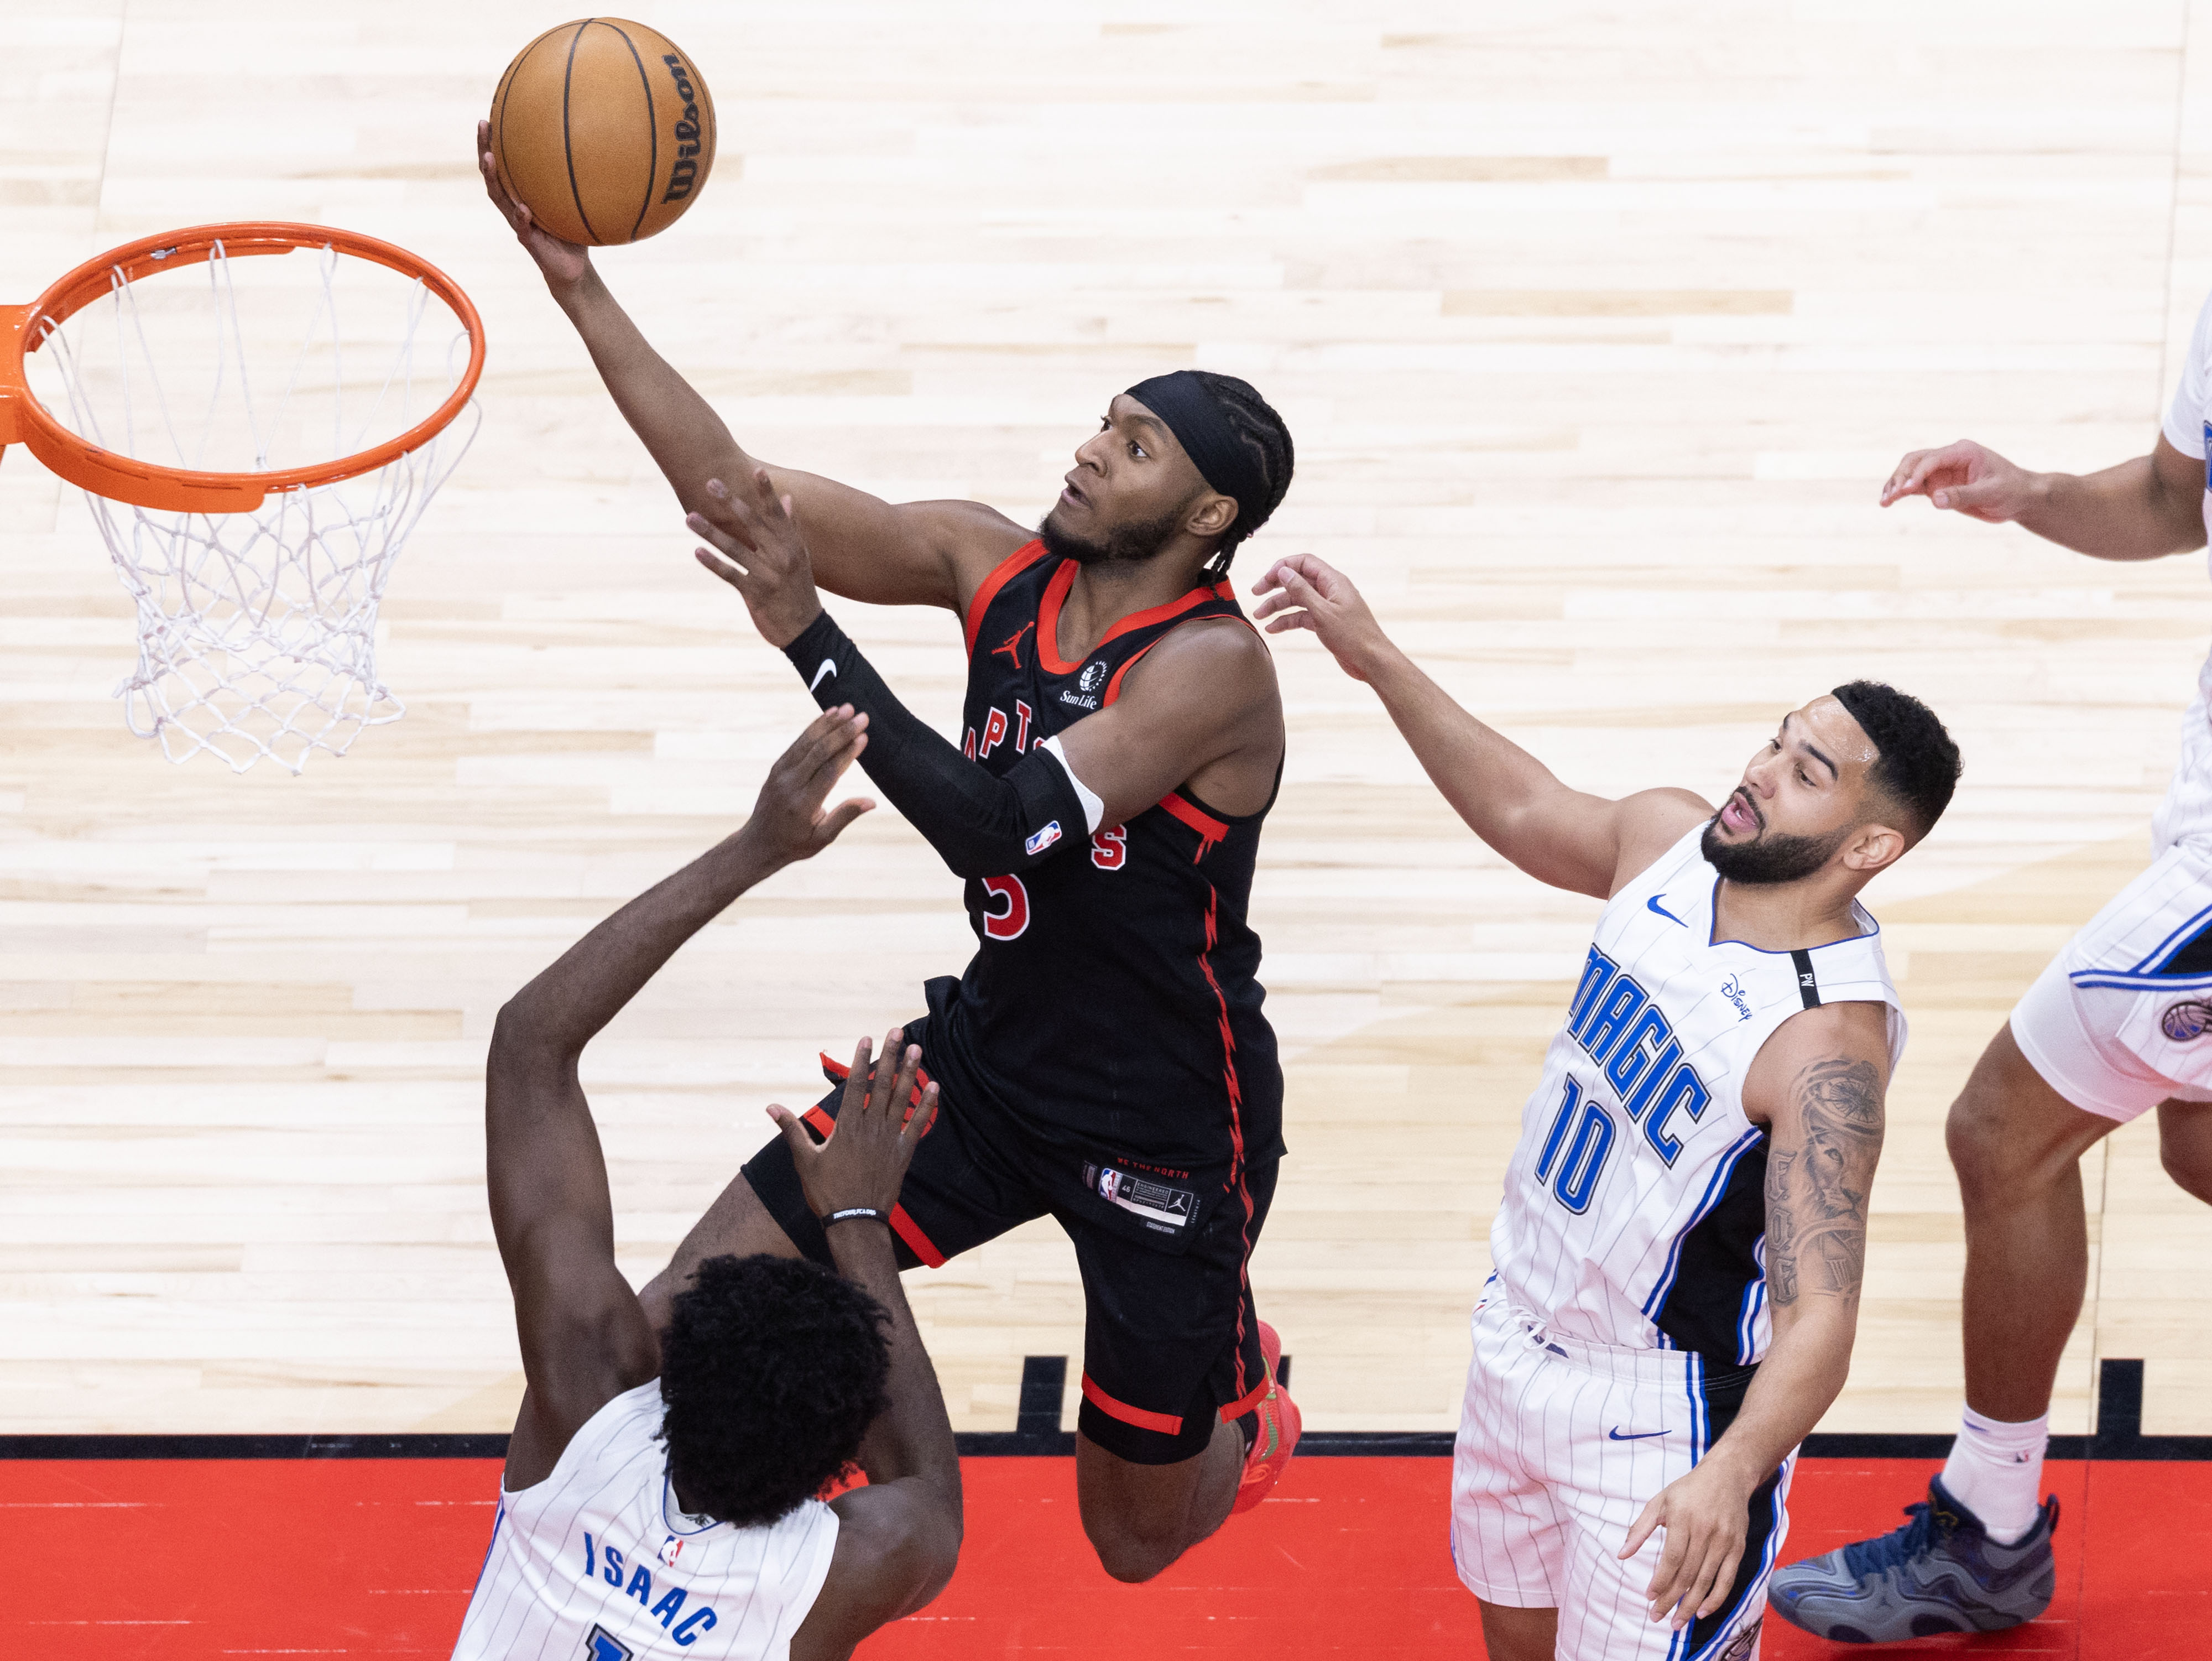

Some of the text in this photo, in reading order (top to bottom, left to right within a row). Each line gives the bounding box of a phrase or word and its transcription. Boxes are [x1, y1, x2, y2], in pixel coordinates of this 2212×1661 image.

[661, 53, 701, 205] Wilson
[1060, 690, 1097, 710] Sun Life
[982, 873, 1030, 941] 5
[1799, 972, 1815, 987] PW
[1567, 942, 1711, 1169] MAGIC
[1535, 1072, 1617, 1215] 10
[1121, 1185, 1131, 1193] 46
[1137, 1182, 1169, 1194] ENGINEERED
[1154, 1167, 1190, 1179] NORTH
[583, 1532, 718, 1647] ISAAC
